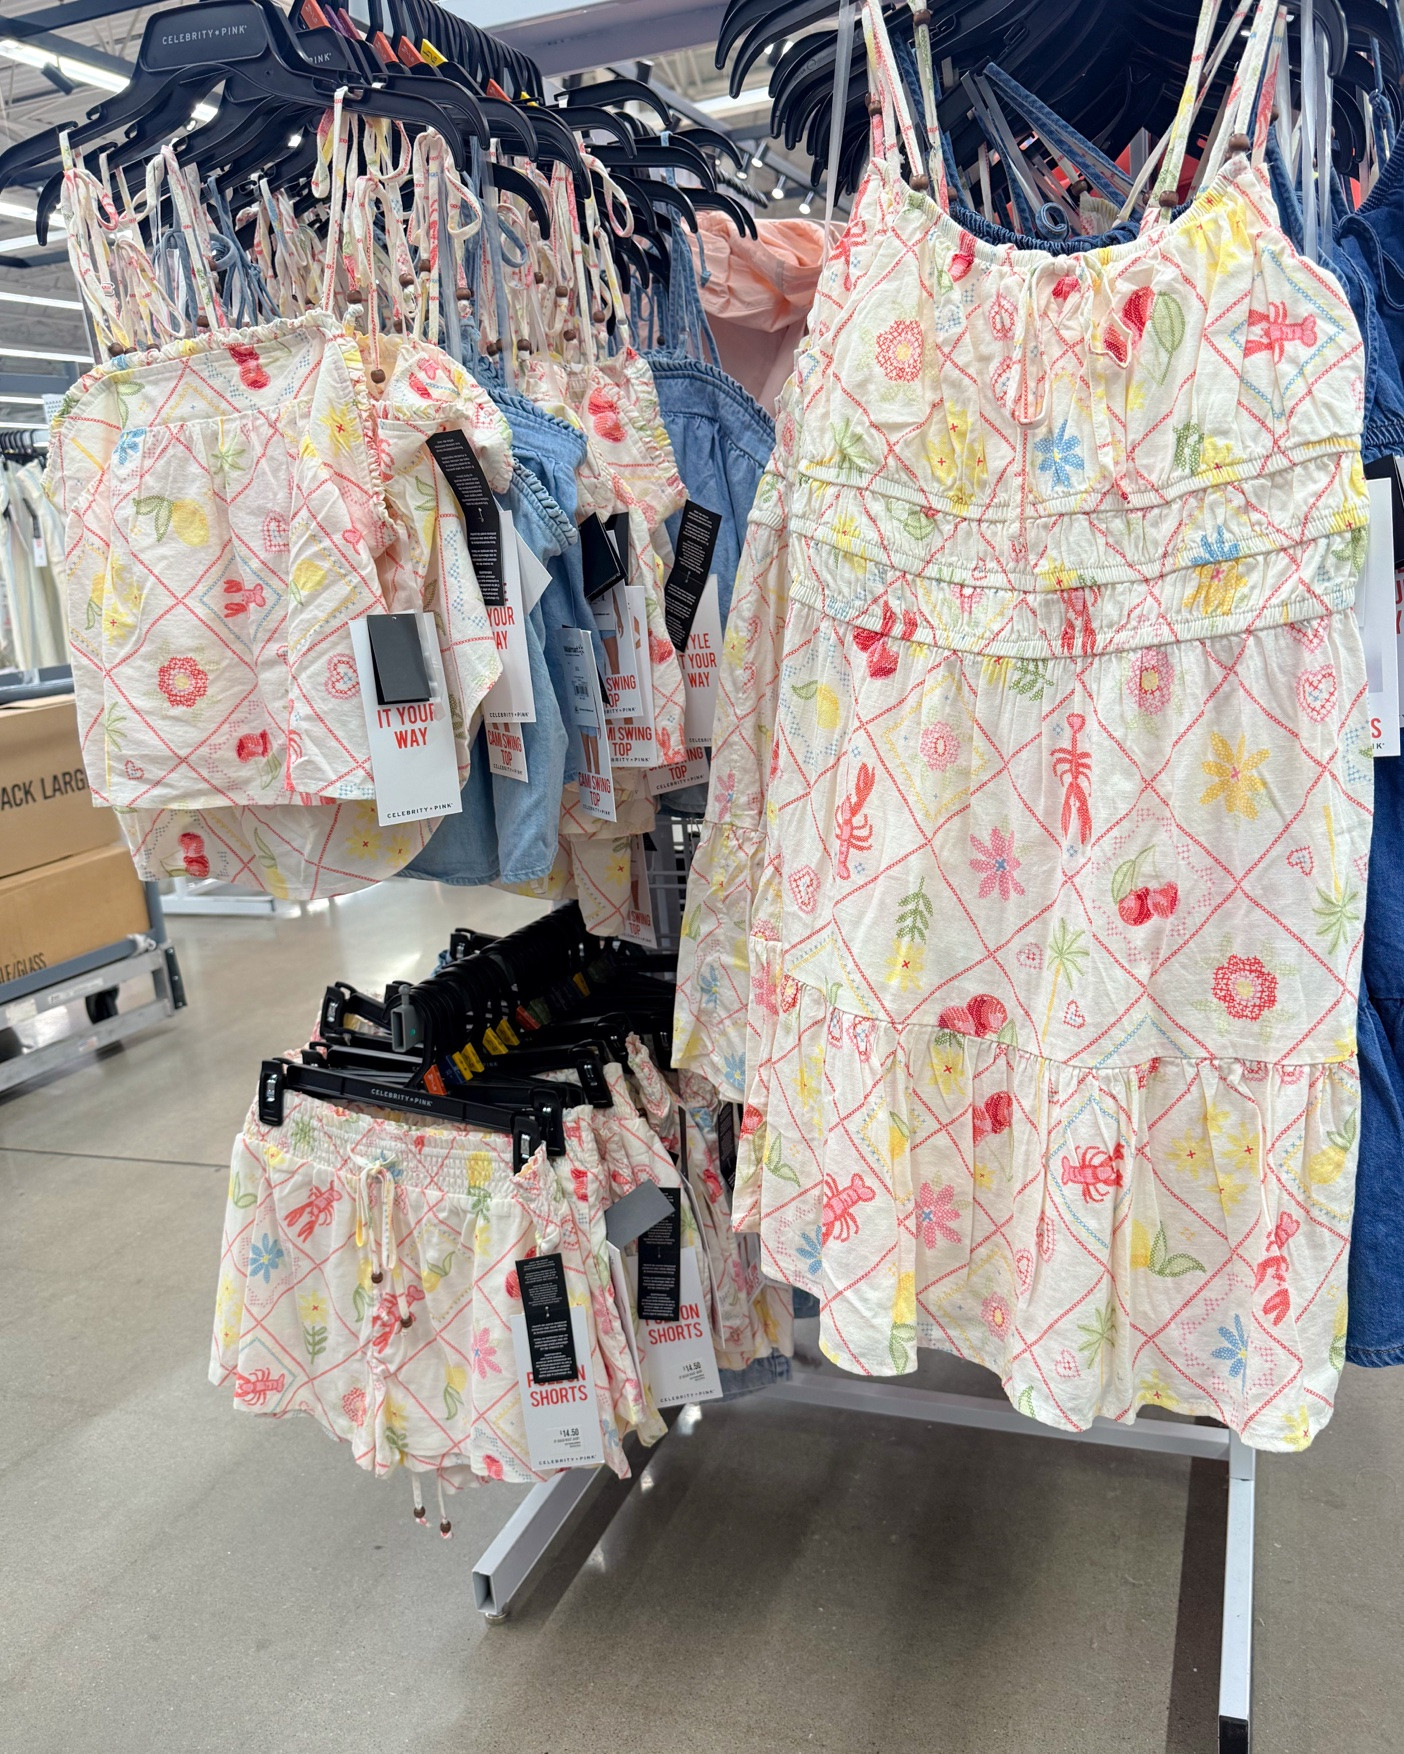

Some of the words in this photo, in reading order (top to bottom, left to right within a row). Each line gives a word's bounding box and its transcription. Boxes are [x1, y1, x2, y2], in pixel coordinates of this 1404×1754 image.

[162, 29, 214, 45] CELEBRITY
[221, 25, 245, 36] PINK
[486, 606, 515, 627] YOUR
[492, 630, 507, 650] AY
[688, 652, 717, 670] YOUR
[606, 674, 637, 692] SWING
[687, 671, 710, 688] WAY
[605, 692, 620, 709] OP
[376, 708, 392, 729] IT
[394, 726, 428, 750] WAY
[487, 730, 503, 748] CAMI
[502, 733, 522, 753] SWING
[617, 726, 653, 741] SWING
[500, 749, 513, 767] TOP
[611, 742, 633, 757] TOP
[668, 764, 687, 781] TOP
[40, 768, 90, 800] LARG
[591, 775, 611, 794] SWING
[656, 779, 686, 790] CELEBRITY
[589, 790, 601, 807] TOP
[386, 806, 428, 819] CELEBRITY
[434, 802, 452, 810] PINK
[371, 1088, 410, 1101] CELEBRITY
[414, 1097, 432, 1106] PINK
[679, 1303, 701, 1321] ON
[648, 1322, 703, 1345] SHORTS
[530, 1384, 588, 1408] SHORTS
